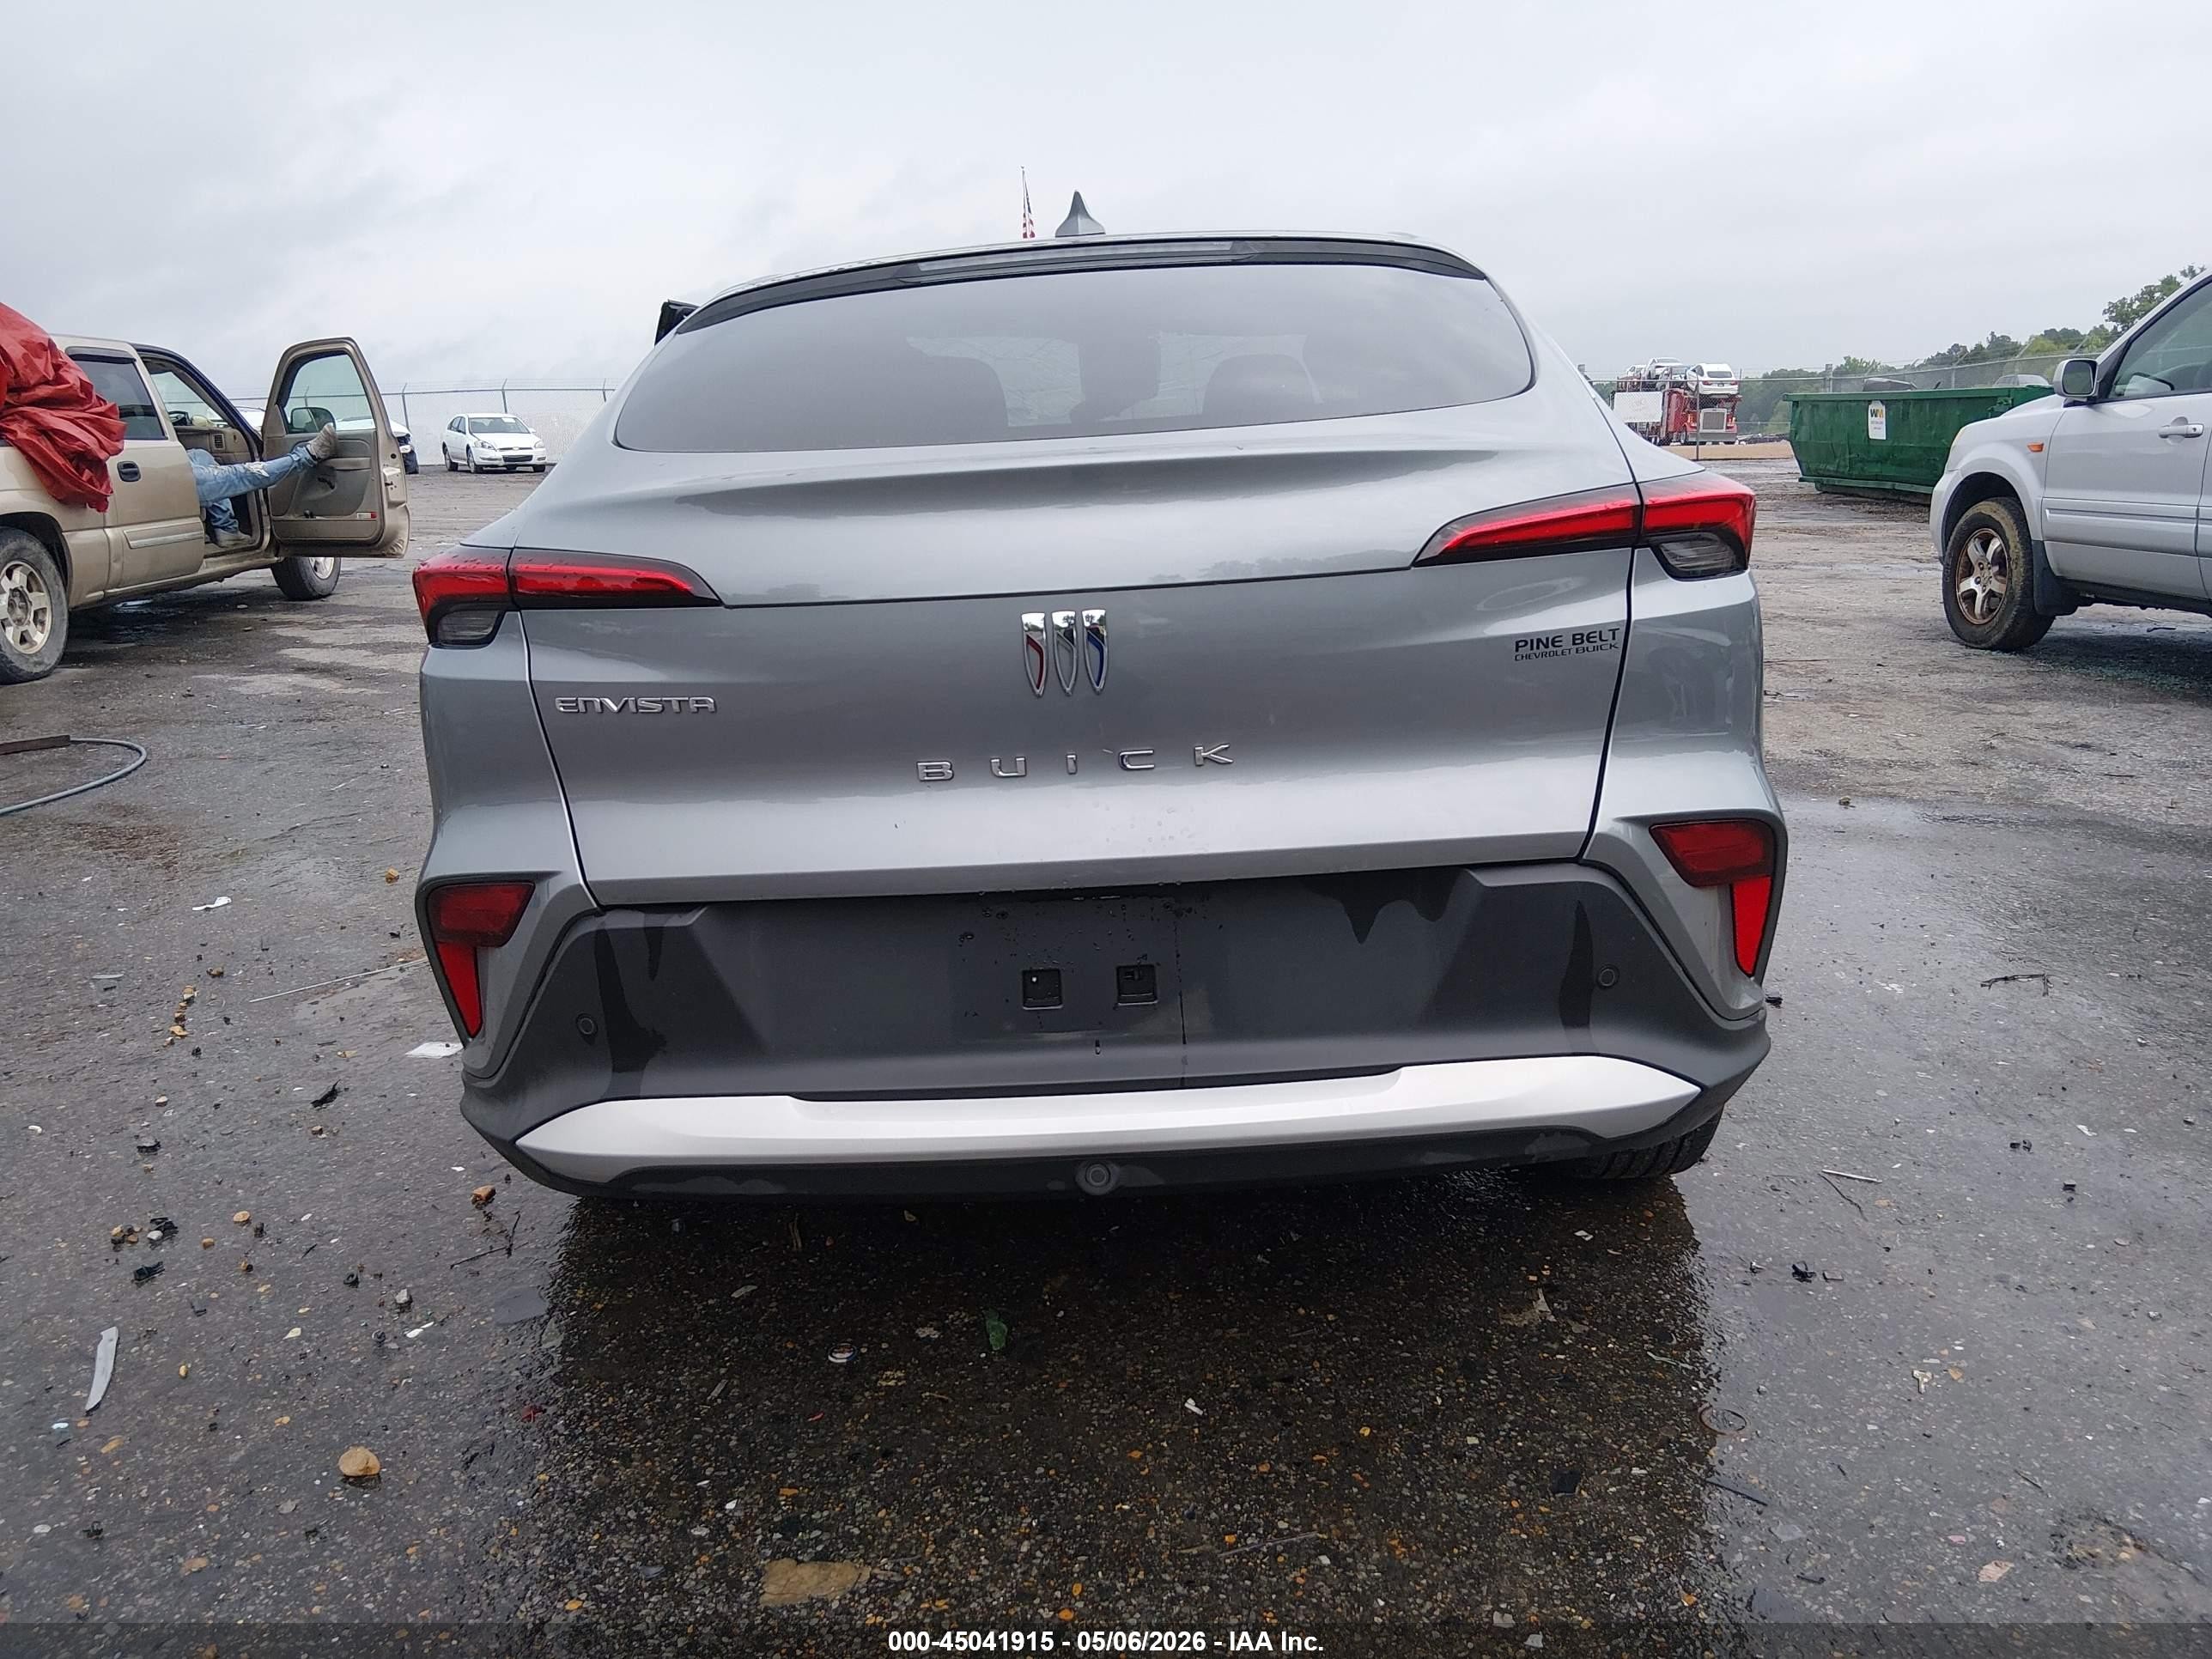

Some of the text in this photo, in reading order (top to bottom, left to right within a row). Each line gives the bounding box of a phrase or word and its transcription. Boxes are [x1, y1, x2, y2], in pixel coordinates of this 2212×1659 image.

[1870, 409, 1883, 418] WM
[1515, 628, 1620, 653] PINE BELT
[1515, 642, 1620, 661] CHEVROLET BUICK
[554, 696, 717, 714] ENVISTA
[916, 744, 1235, 781] BUICK
